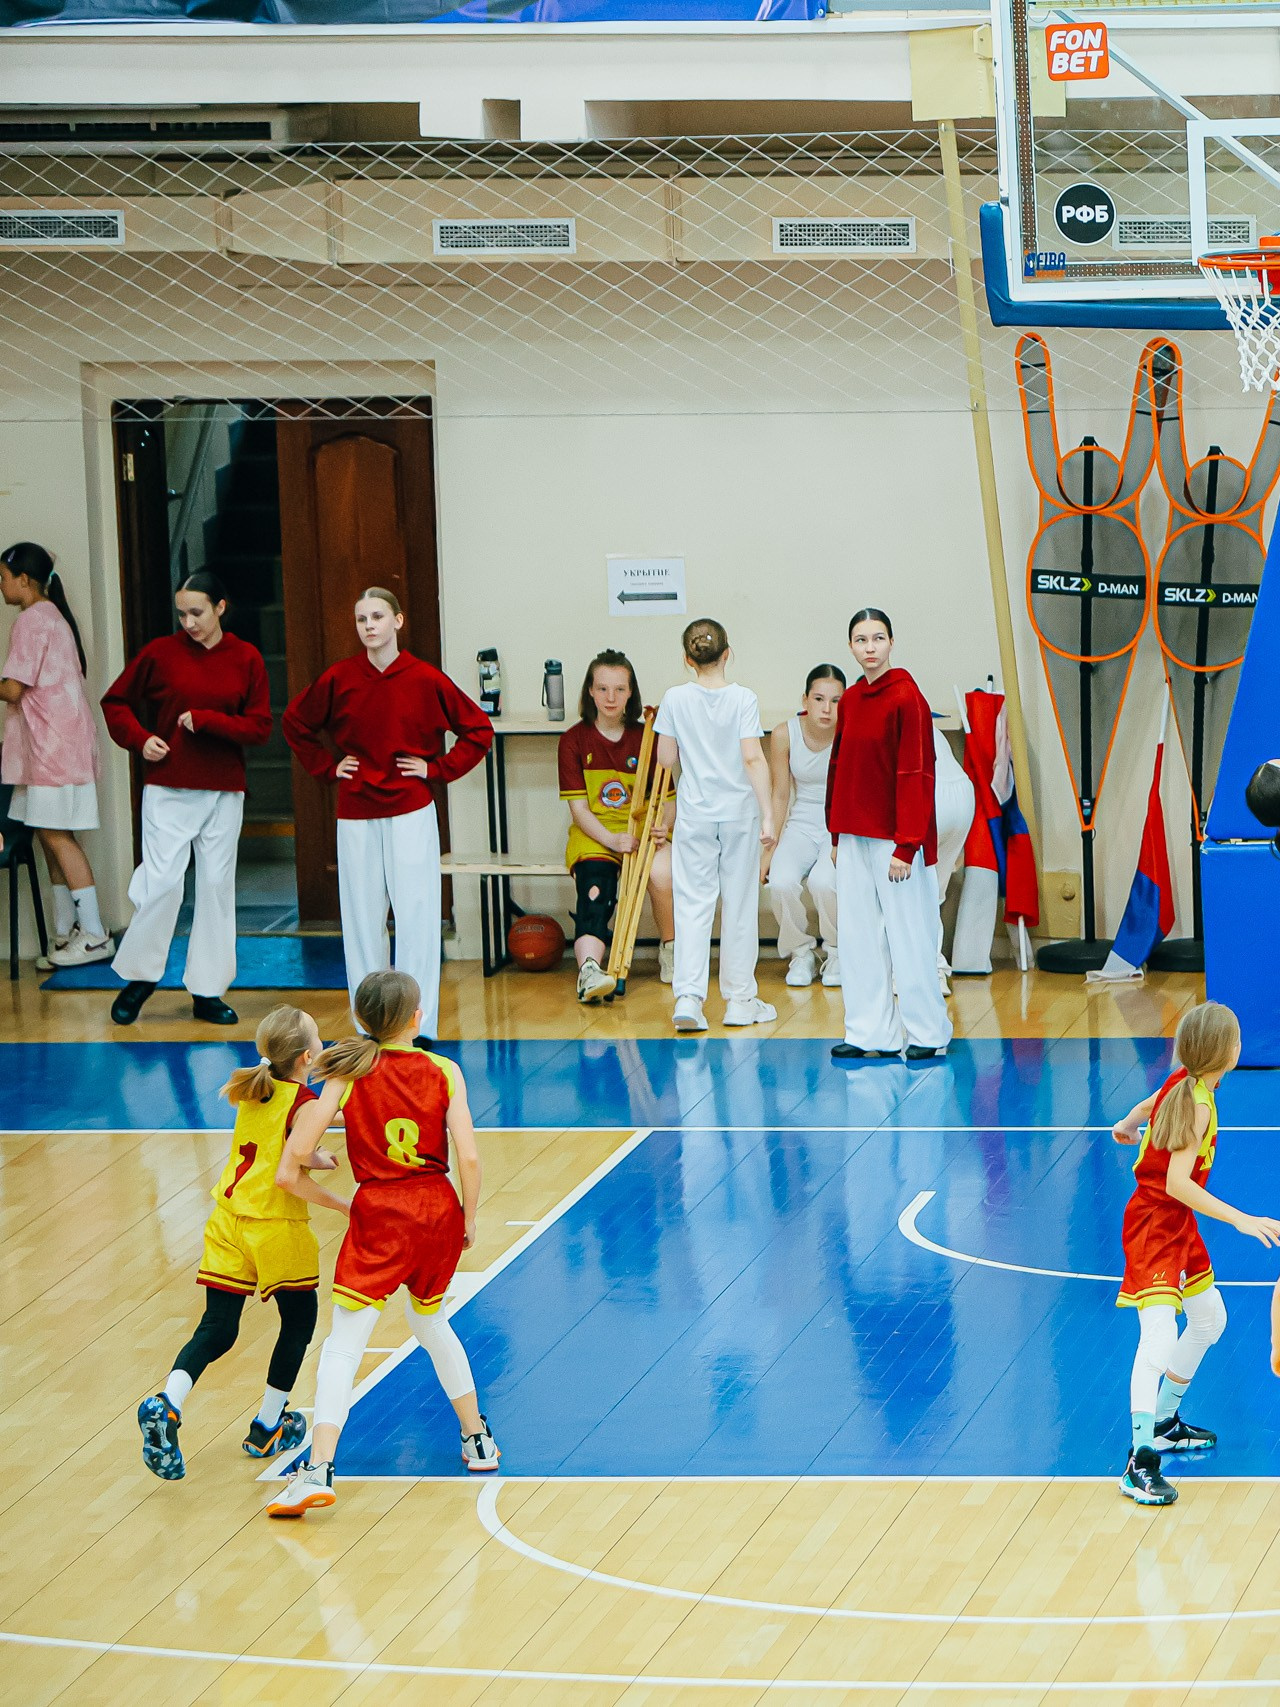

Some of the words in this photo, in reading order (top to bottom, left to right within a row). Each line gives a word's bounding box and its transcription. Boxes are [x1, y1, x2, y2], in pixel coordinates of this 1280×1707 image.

[1050, 28, 1103, 51] FON
[1051, 50, 1104, 74] BET
[1061, 205, 1109, 223] РФБ
[1036, 252, 1066, 270] FIBA
[1037, 574, 1081, 591] SKLZ
[1098, 582, 1139, 595] D-MAN
[1164, 587, 1207, 603] SKLZ
[385, 1117, 426, 1167] 8
